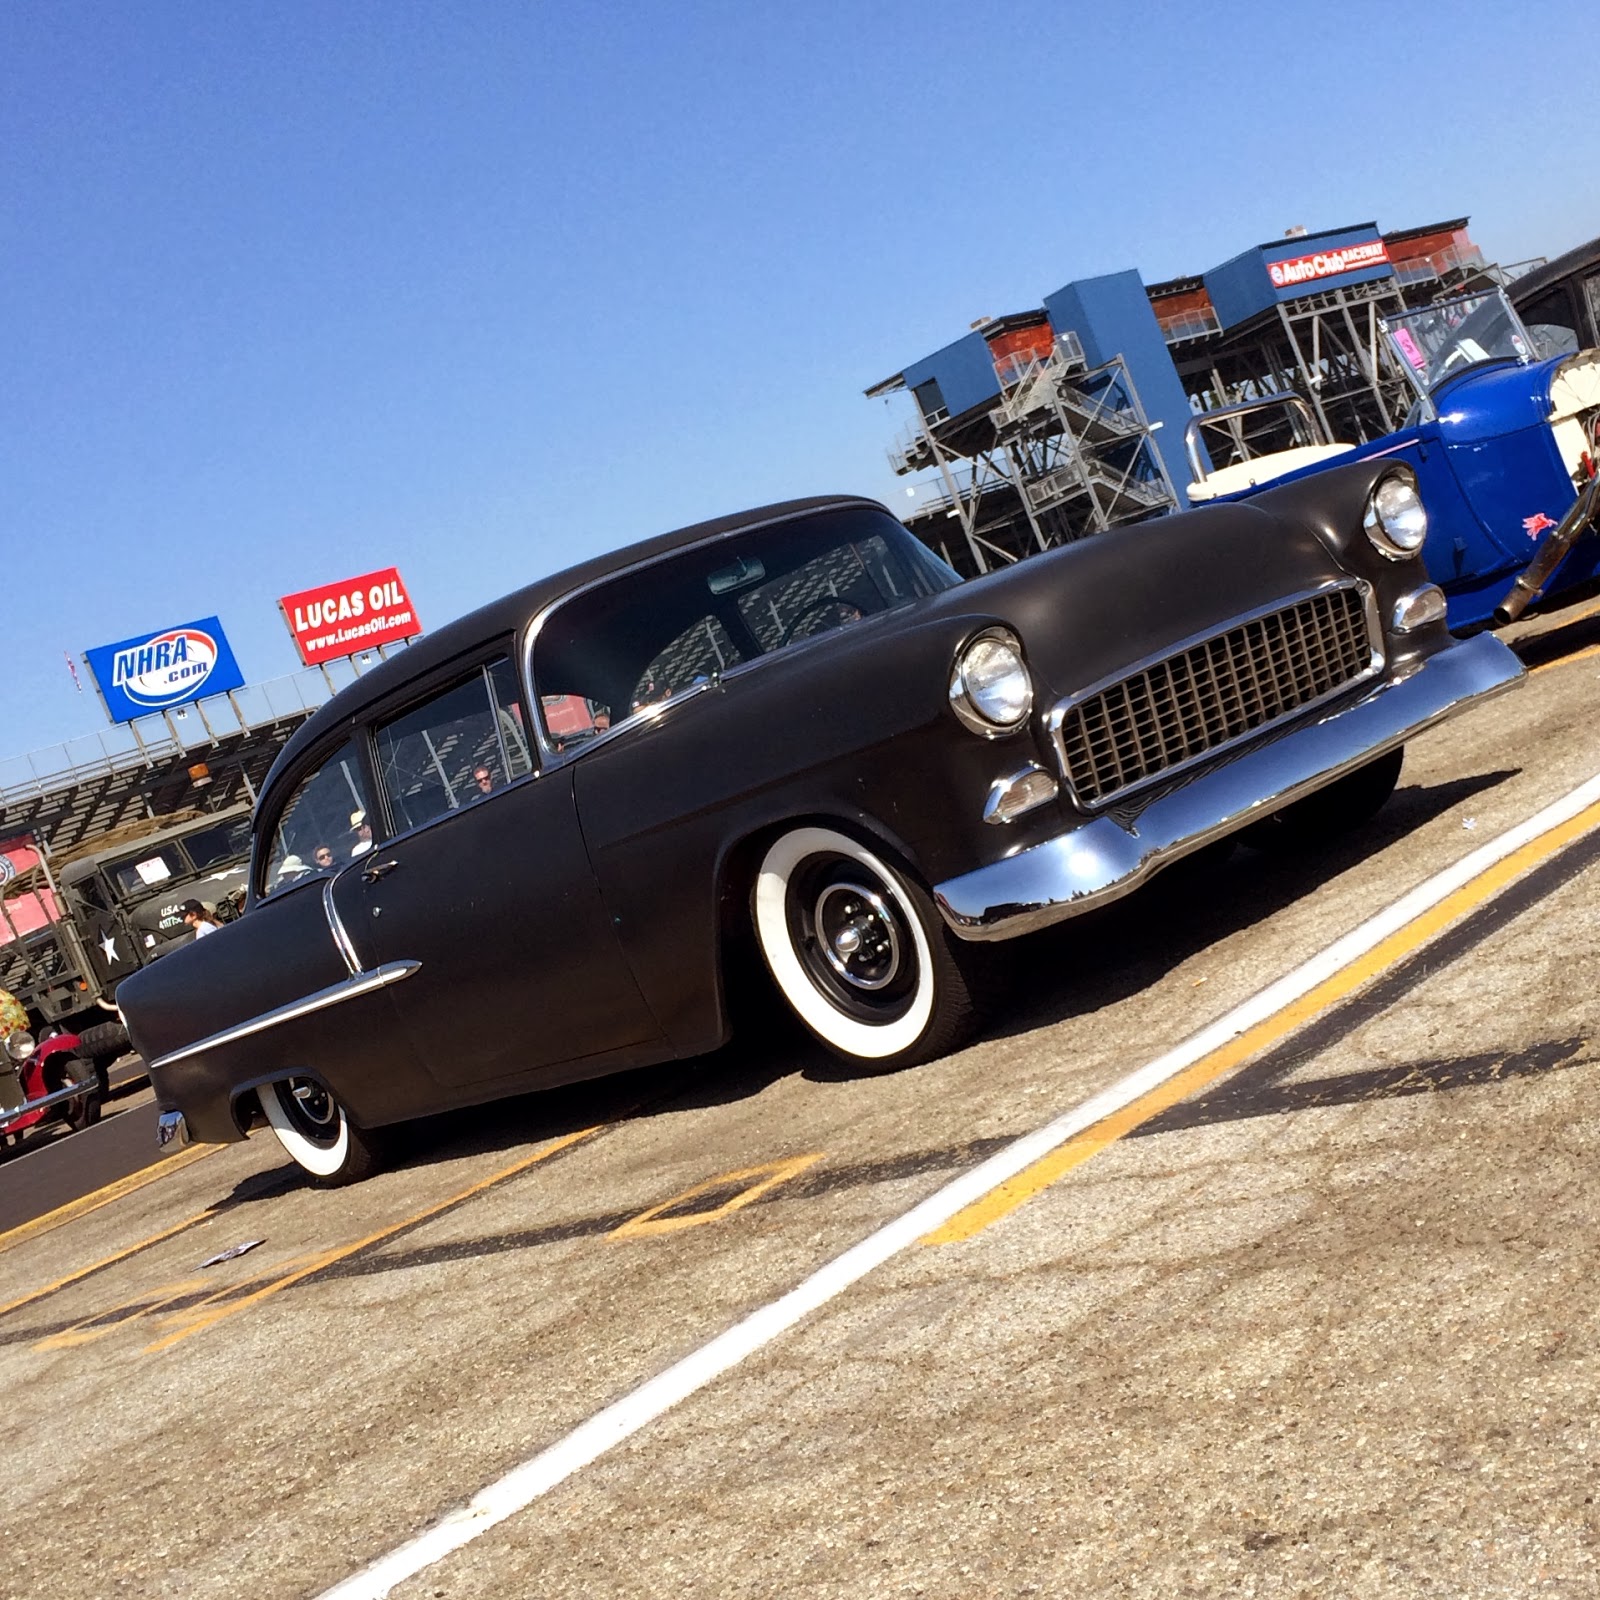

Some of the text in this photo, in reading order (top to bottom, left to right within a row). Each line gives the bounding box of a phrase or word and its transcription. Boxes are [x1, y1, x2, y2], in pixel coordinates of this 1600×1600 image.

[1341, 242, 1383, 263] RACEWAY
[294, 581, 404, 632] LUCAS OIL
[305, 611, 412, 652] www.LucasOil.com
[115, 635, 188, 684] NHRA
